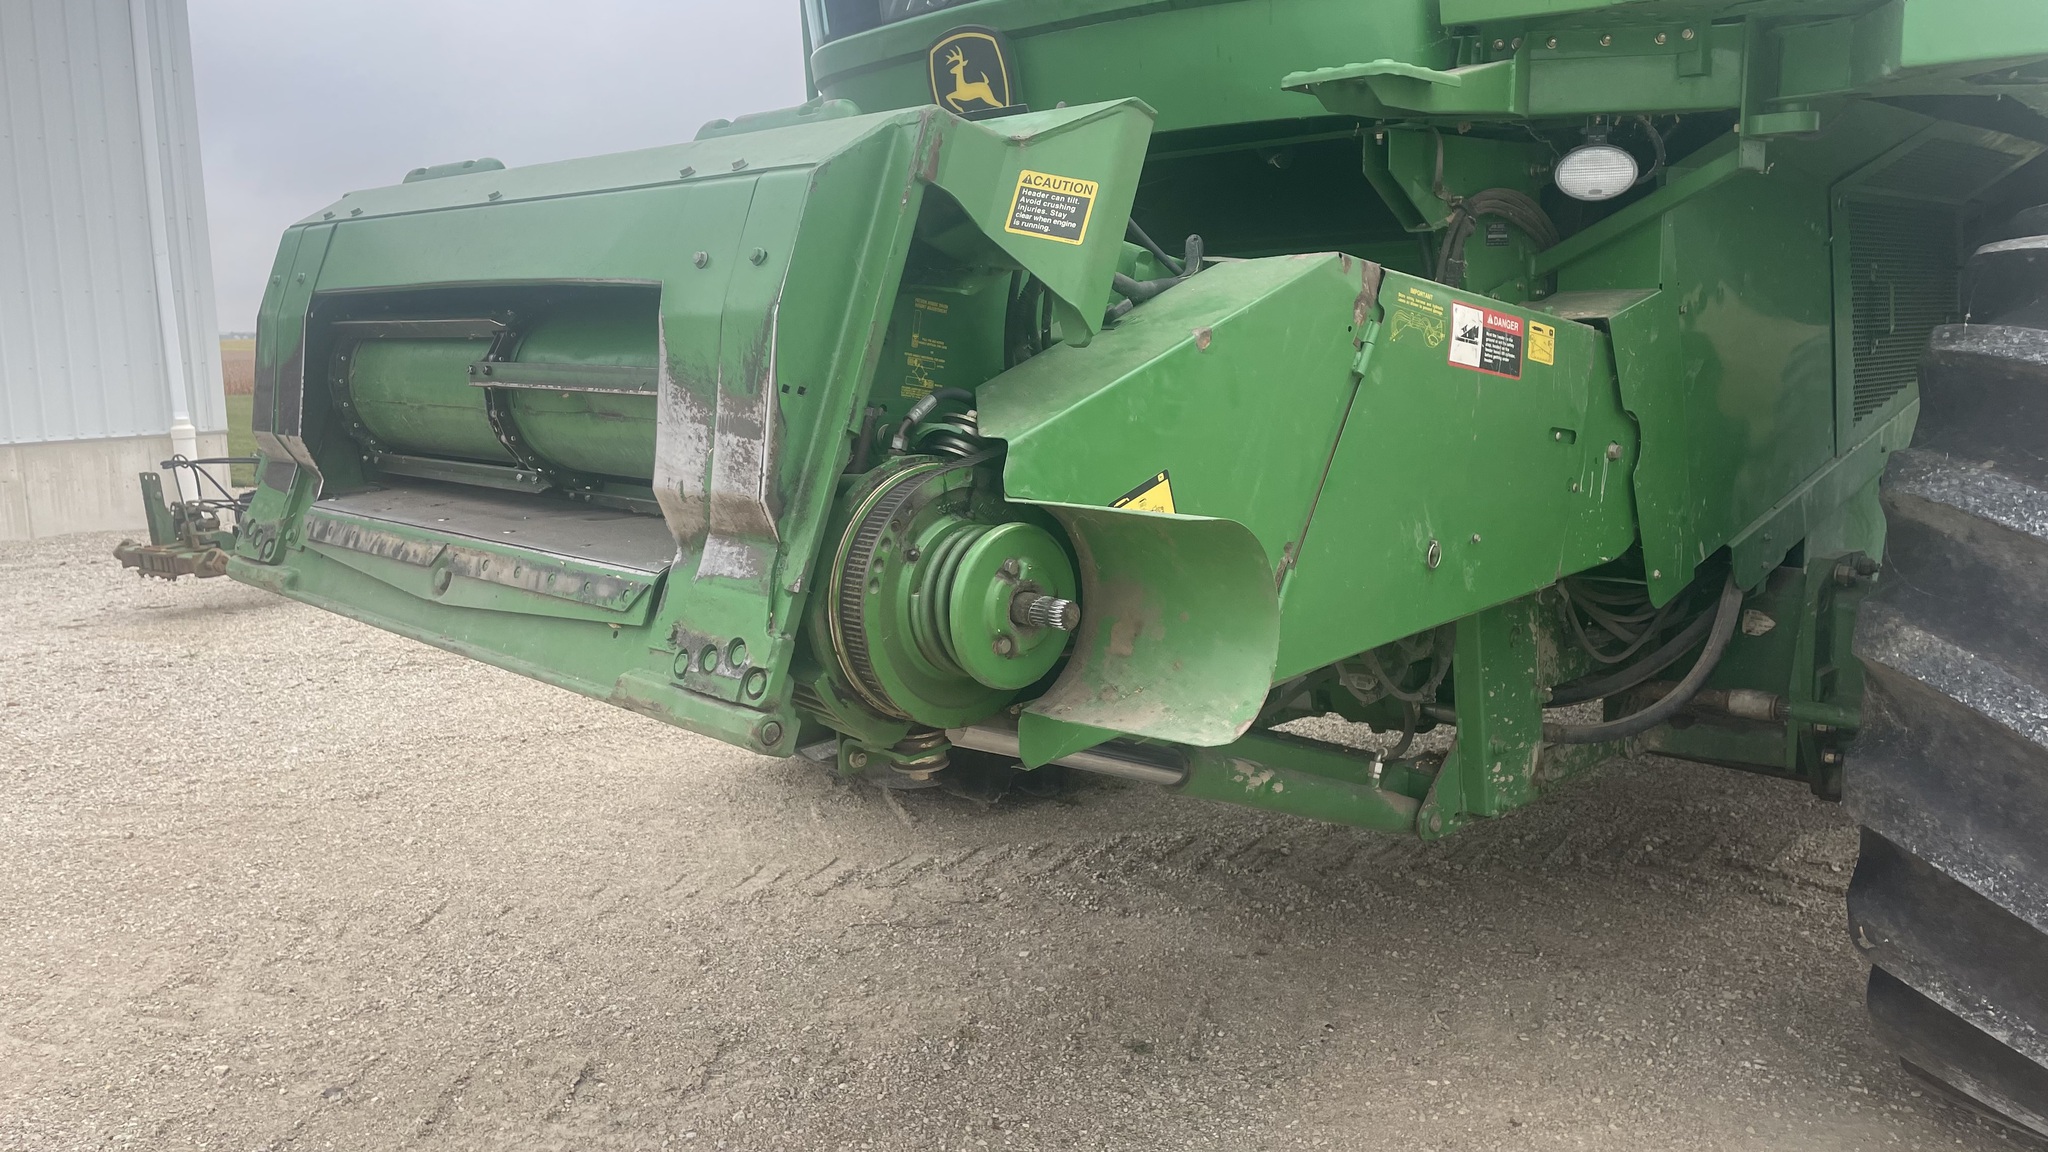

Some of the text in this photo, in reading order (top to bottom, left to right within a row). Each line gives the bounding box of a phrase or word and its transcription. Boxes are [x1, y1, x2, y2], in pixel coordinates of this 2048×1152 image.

[1034, 175, 1094, 195] CAUTION
[1020, 196, 1076, 213] Avoid crushing
[1022, 188, 1080, 205] Header can tilt.
[1017, 203, 1068, 220] injuries. Stay
[1013, 218, 1051, 233] is running.
[1015, 212, 1077, 228] clear when engine
[1410, 287, 1433, 301] IMPORTANT
[1493, 316, 1519, 332] DANGER
